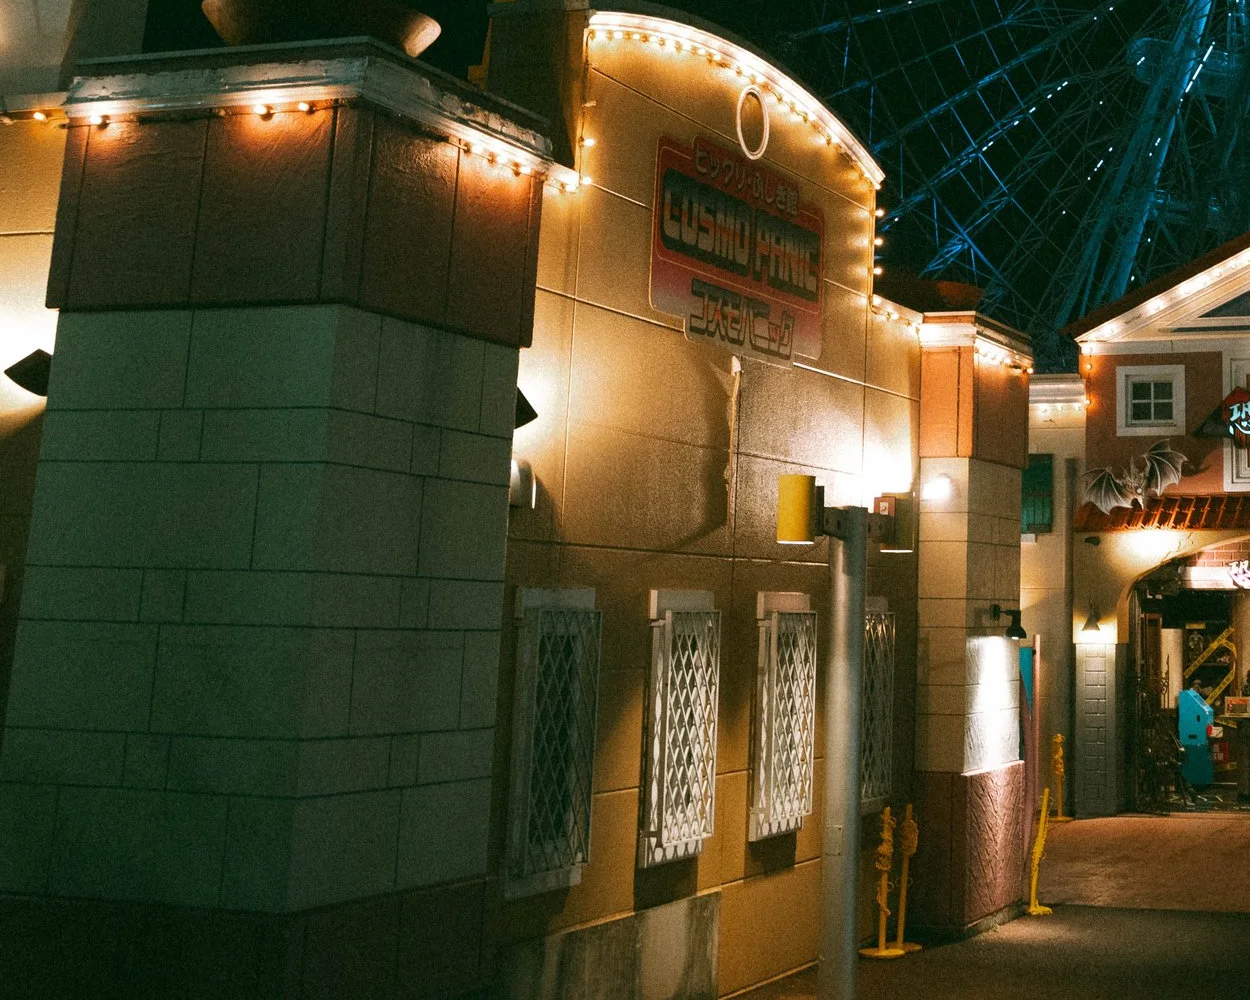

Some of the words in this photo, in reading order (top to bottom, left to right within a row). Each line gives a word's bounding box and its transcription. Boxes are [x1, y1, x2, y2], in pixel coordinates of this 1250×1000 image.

[664, 188, 751, 266] COSMO
[756, 224, 818, 293] PANIC
[690, 278, 795, 360] コスモパニック
